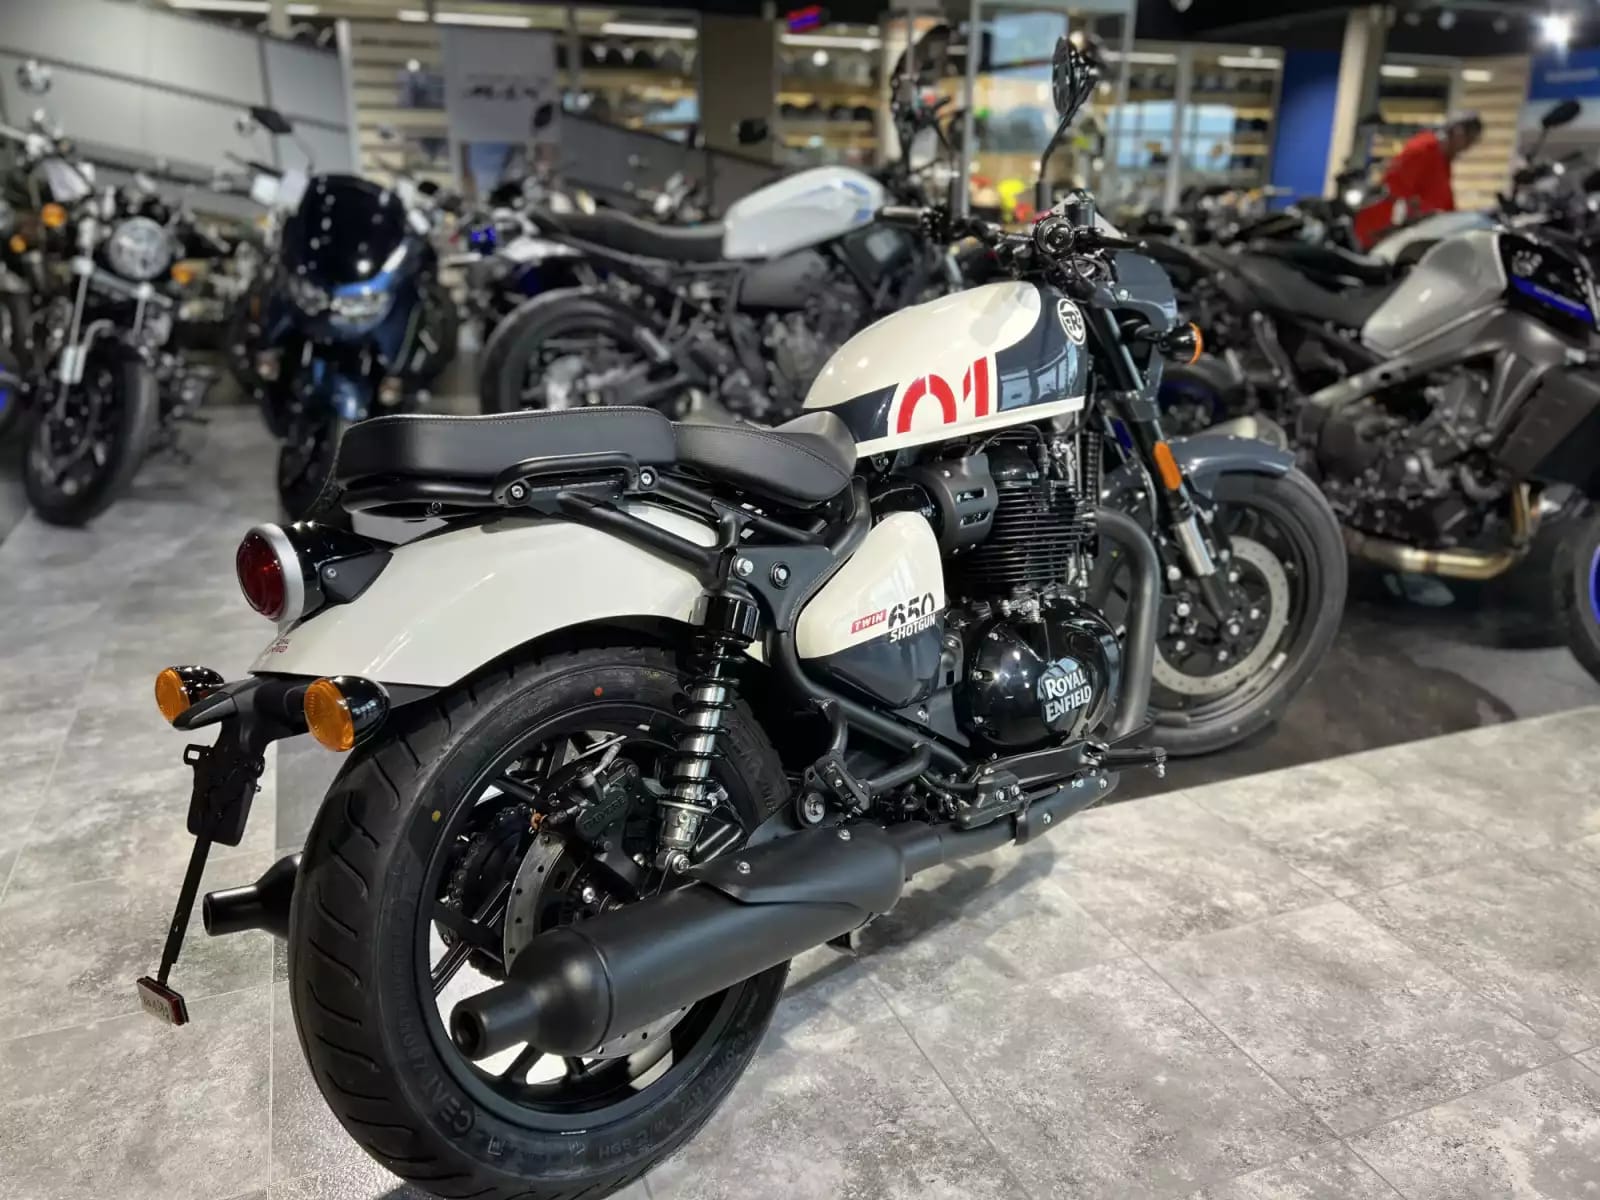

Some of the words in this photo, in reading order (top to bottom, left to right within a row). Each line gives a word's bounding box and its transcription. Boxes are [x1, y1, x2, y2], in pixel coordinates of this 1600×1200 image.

[852, 611, 886, 633] TWIN
[888, 592, 935, 630] 650
[889, 613, 936, 644] SHOTGUN
[1045, 667, 1087, 700] ROYAL
[1045, 685, 1092, 723] ENFIELD
